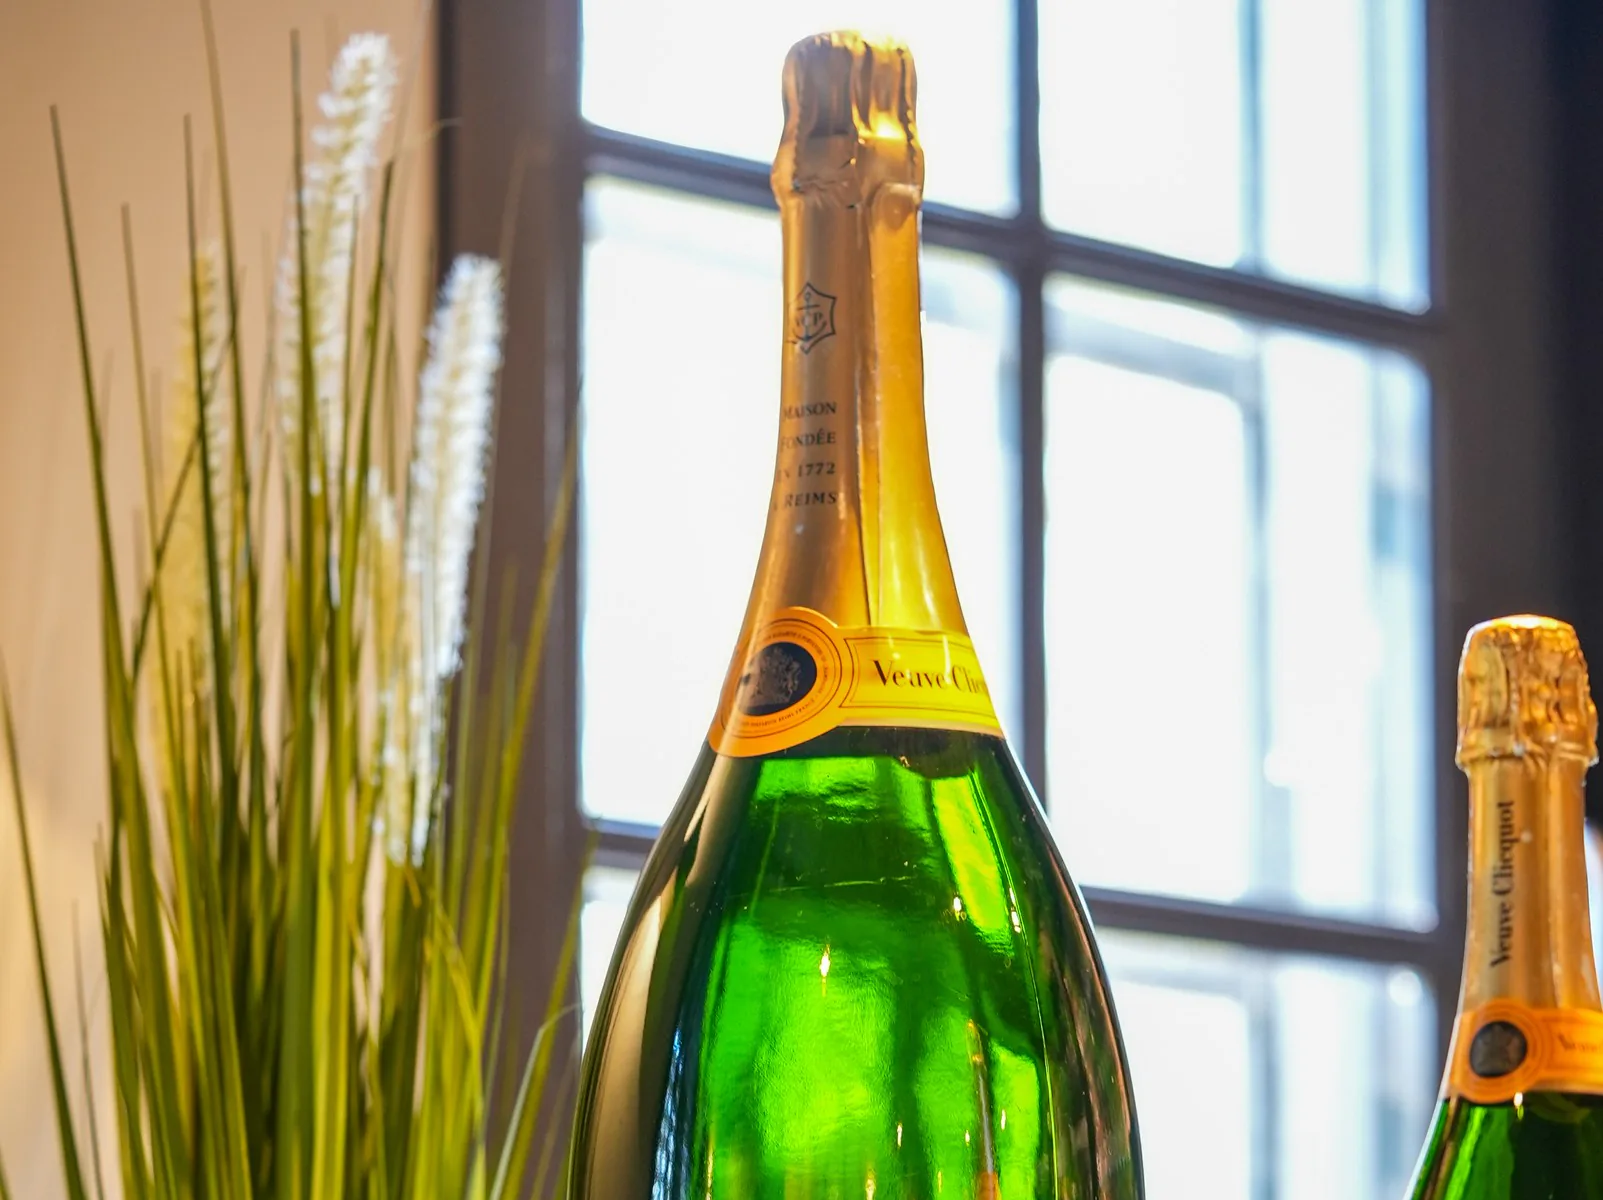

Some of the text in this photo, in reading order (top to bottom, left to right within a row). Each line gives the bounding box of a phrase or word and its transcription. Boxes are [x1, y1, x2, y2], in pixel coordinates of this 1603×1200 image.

[797, 461, 836, 478] 1772
[784, 491, 837, 507] REIMS
[873, 660, 946, 688] Veuve
[1492, 800, 1519, 896] Clicquot
